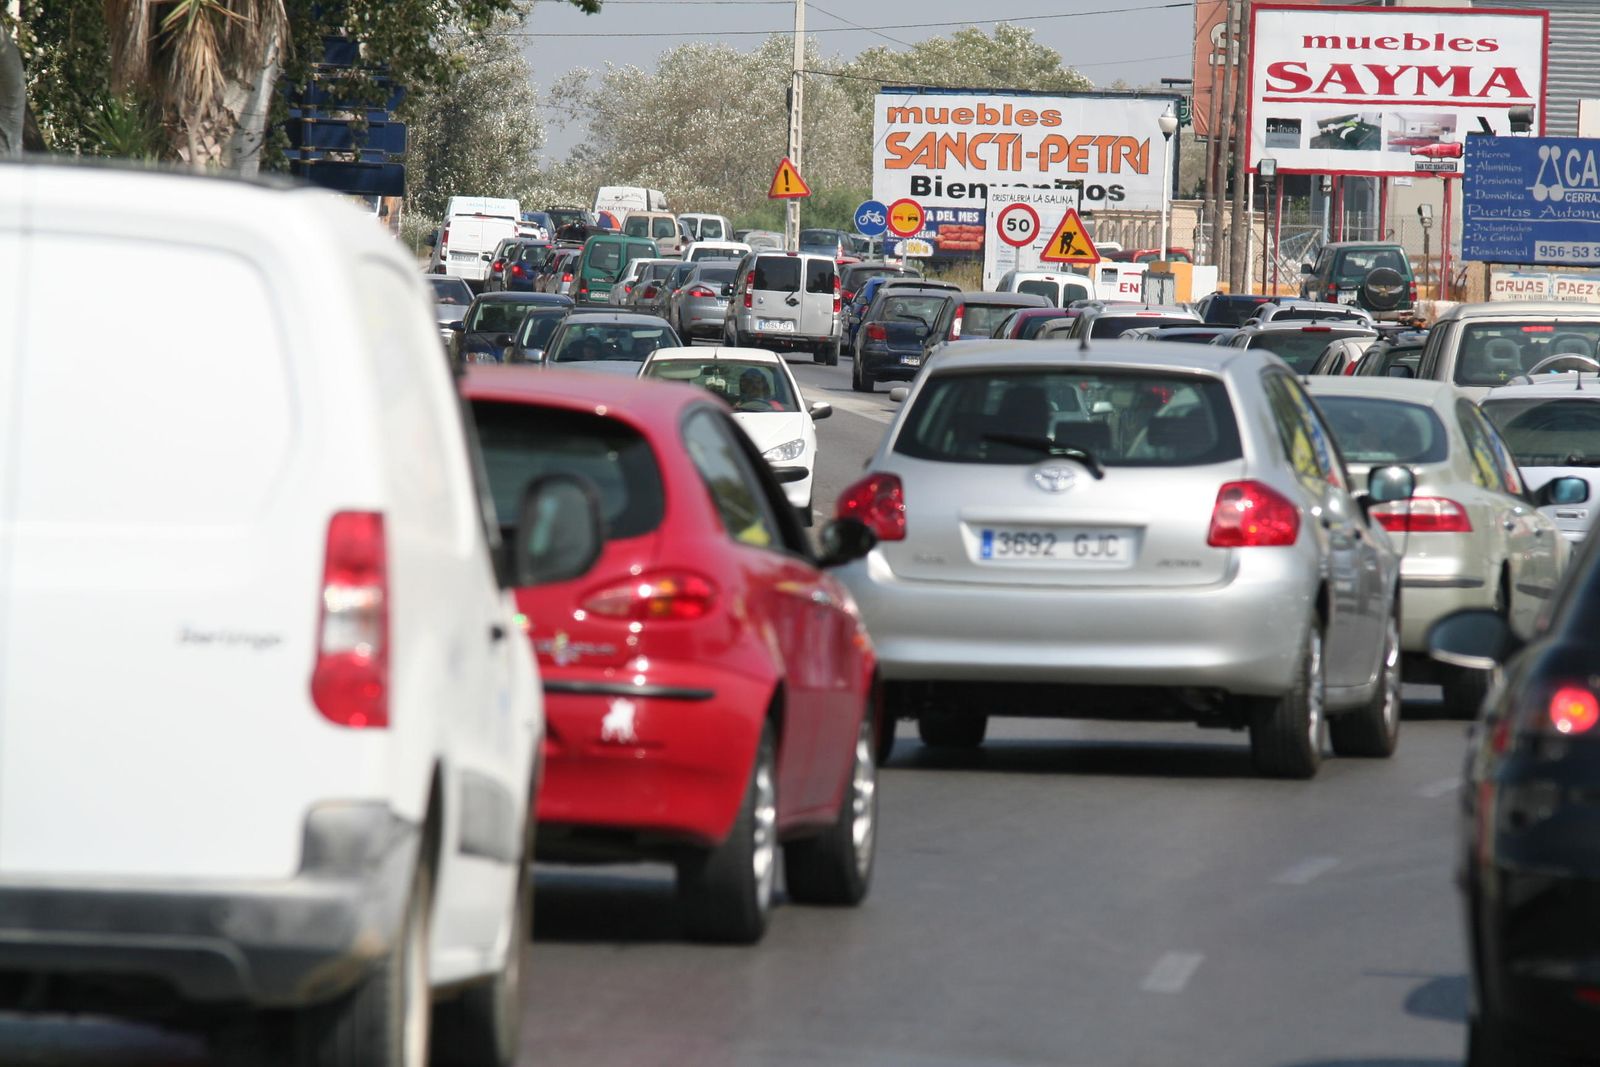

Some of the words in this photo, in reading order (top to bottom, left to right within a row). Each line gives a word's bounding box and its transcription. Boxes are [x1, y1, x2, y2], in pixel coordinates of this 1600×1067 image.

[1301, 32, 1499, 51] muebles
[1265, 61, 1533, 98] SAYMA
[887, 103, 1063, 127] muebles
[884, 131, 1151, 175] SANCTI-PETRI
[1475, 150, 1510, 159] Hierros
[1475, 161, 1522, 172] Aluminios
[1475, 175, 1523, 185] Persianas
[1033, 194, 1043, 203] LA
[1044, 195, 1074, 205] SALINA
[936, 210, 953, 221] DEL
[958, 211, 980, 223] MES
[1467, 204, 1531, 218] Puertas
[1006, 218, 1030, 232] 50
[1472, 233, 1488, 242] De
[1490, 233, 1523, 242] Cristal
[1470, 245, 1528, 257] Residencial
[1539, 245, 1589, 258] 956-53
[1495, 280, 1544, 293] GRUAS
[1557, 282, 1594, 295] PAEZ
[998, 531, 1057, 557] 3692
[1073, 534, 1119, 558] GJC
